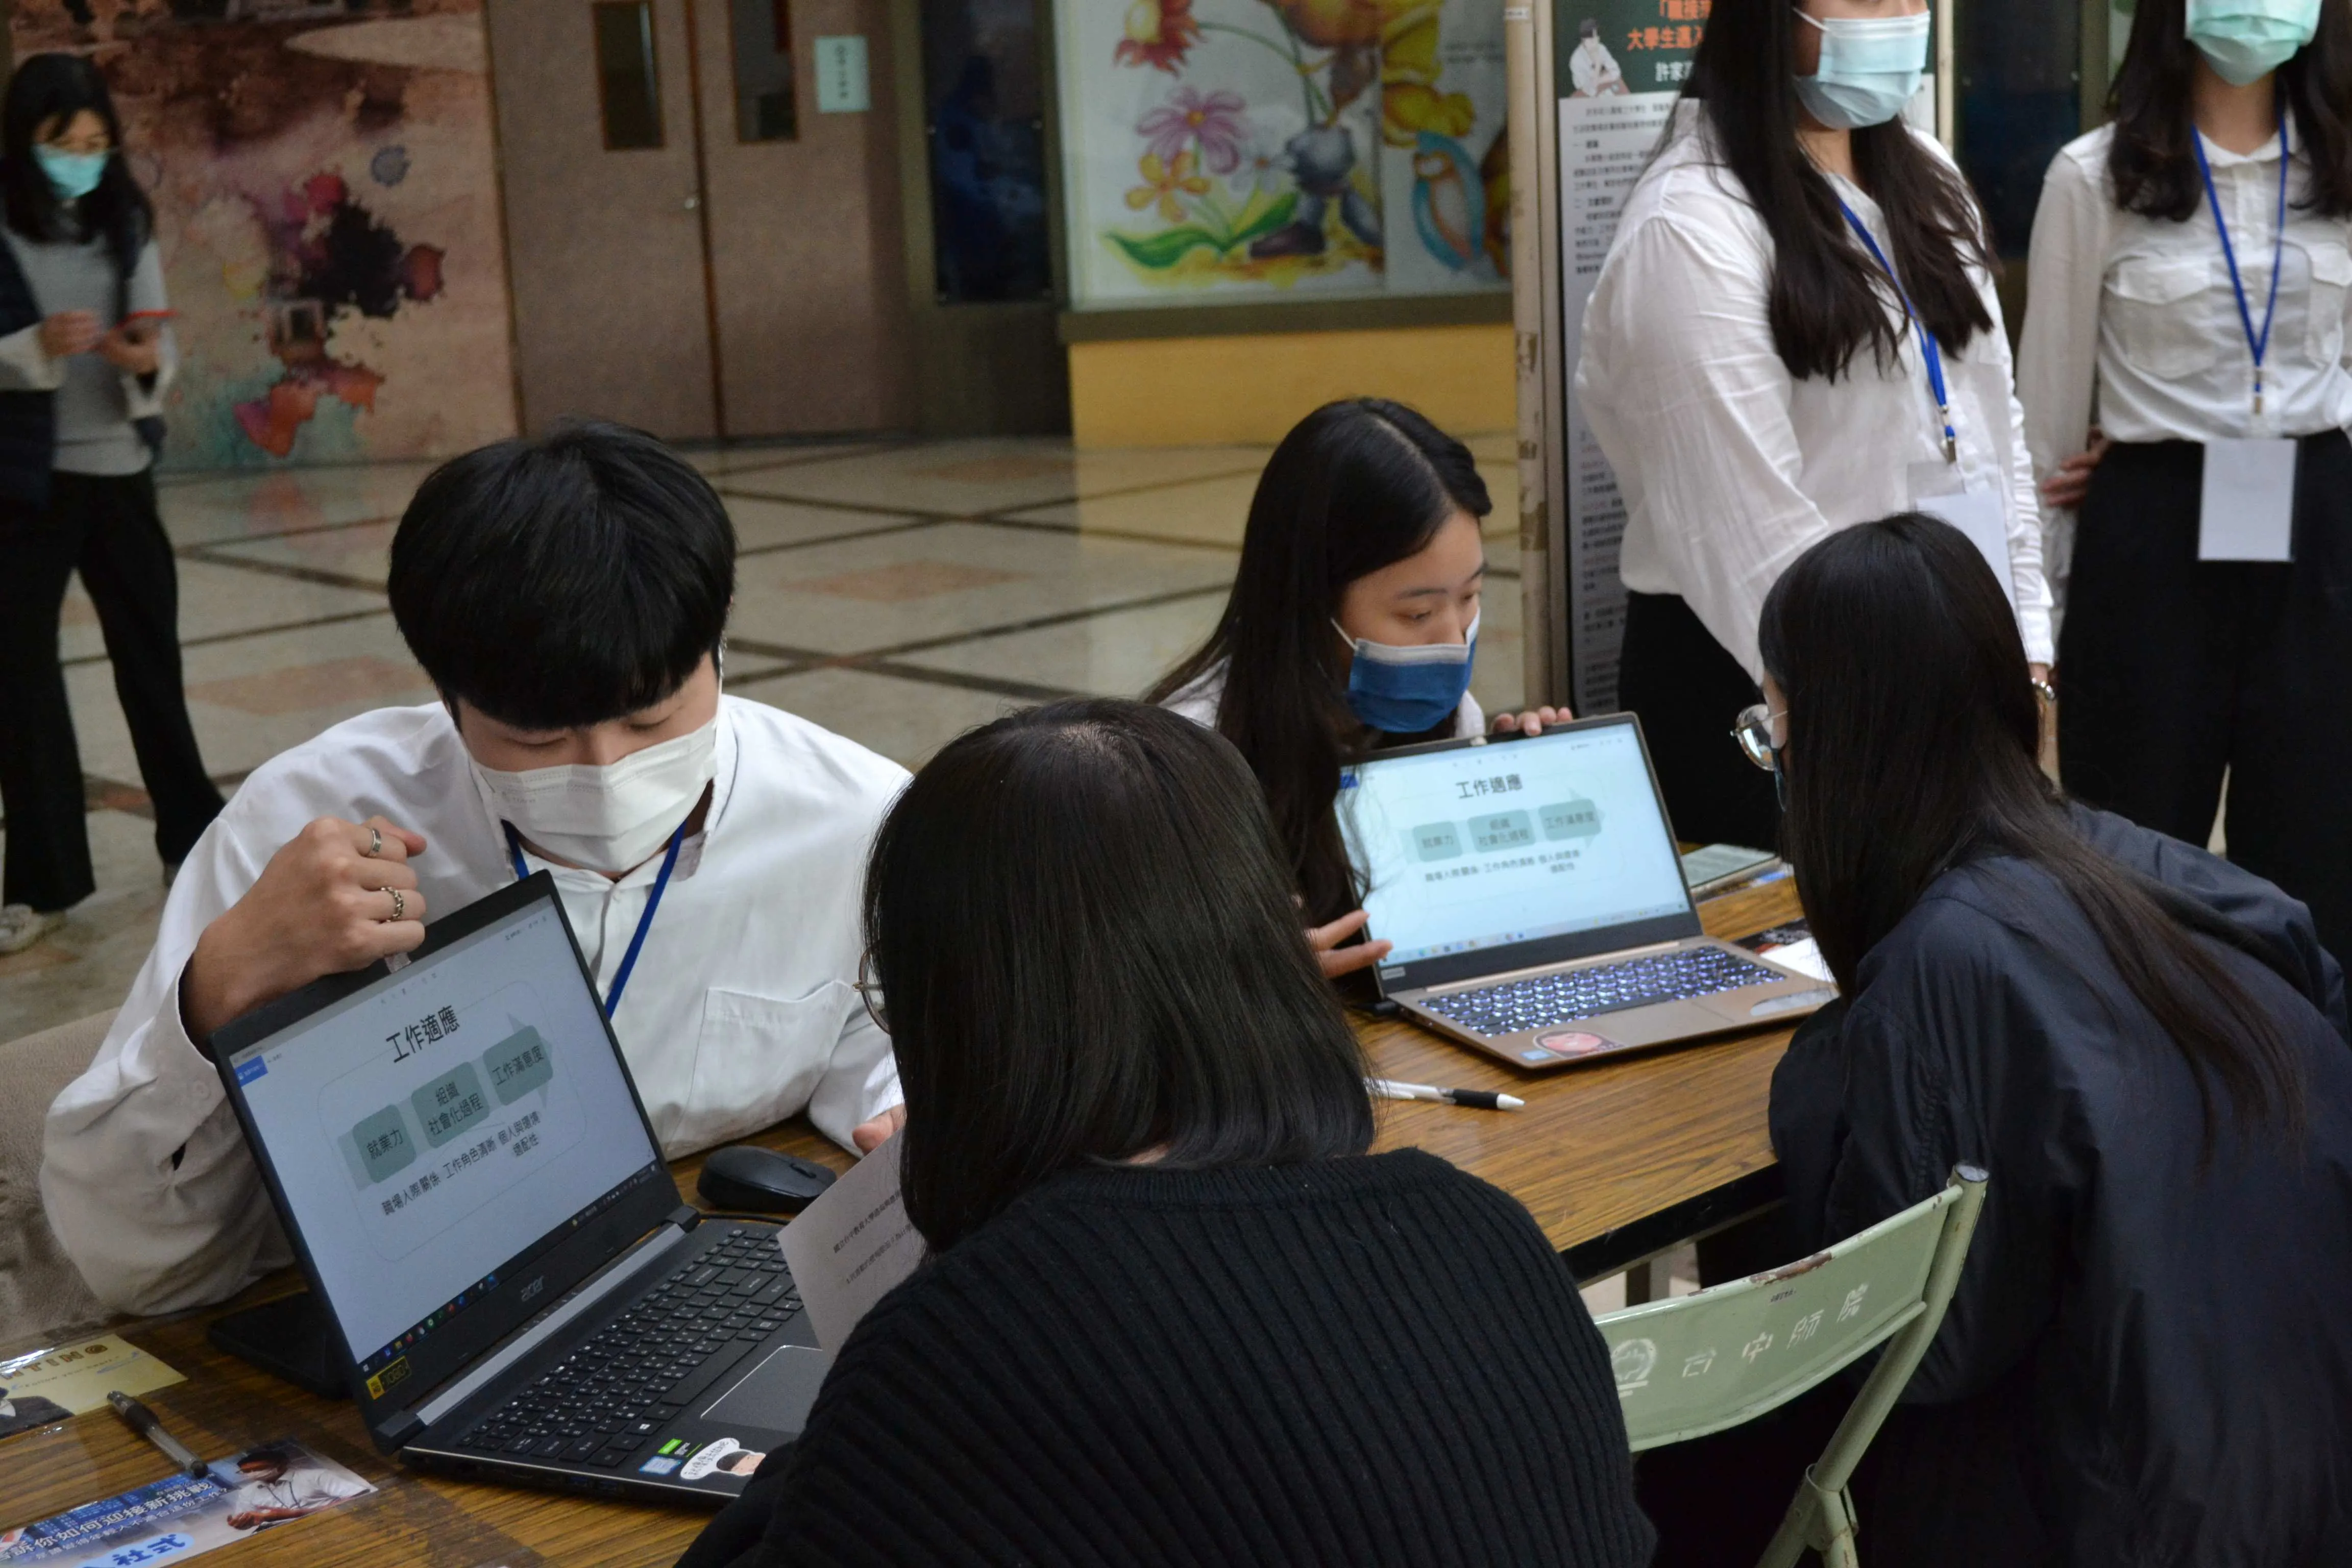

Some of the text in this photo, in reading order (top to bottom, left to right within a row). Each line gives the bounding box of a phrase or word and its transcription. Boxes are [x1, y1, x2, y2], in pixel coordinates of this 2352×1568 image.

[386, 1005, 459, 1063] 工作適應
[492, 1045, 544, 1086] 工作滿意度
[436, 1082, 460, 1107] 組織
[428, 1093, 483, 1135] 社會化過程
[366, 1129, 403, 1160] 就業力
[381, 1170, 441, 1215] 職場人際關係
[521, 1276, 544, 1302] acer
[83, 1534, 185, 1568] 社式
